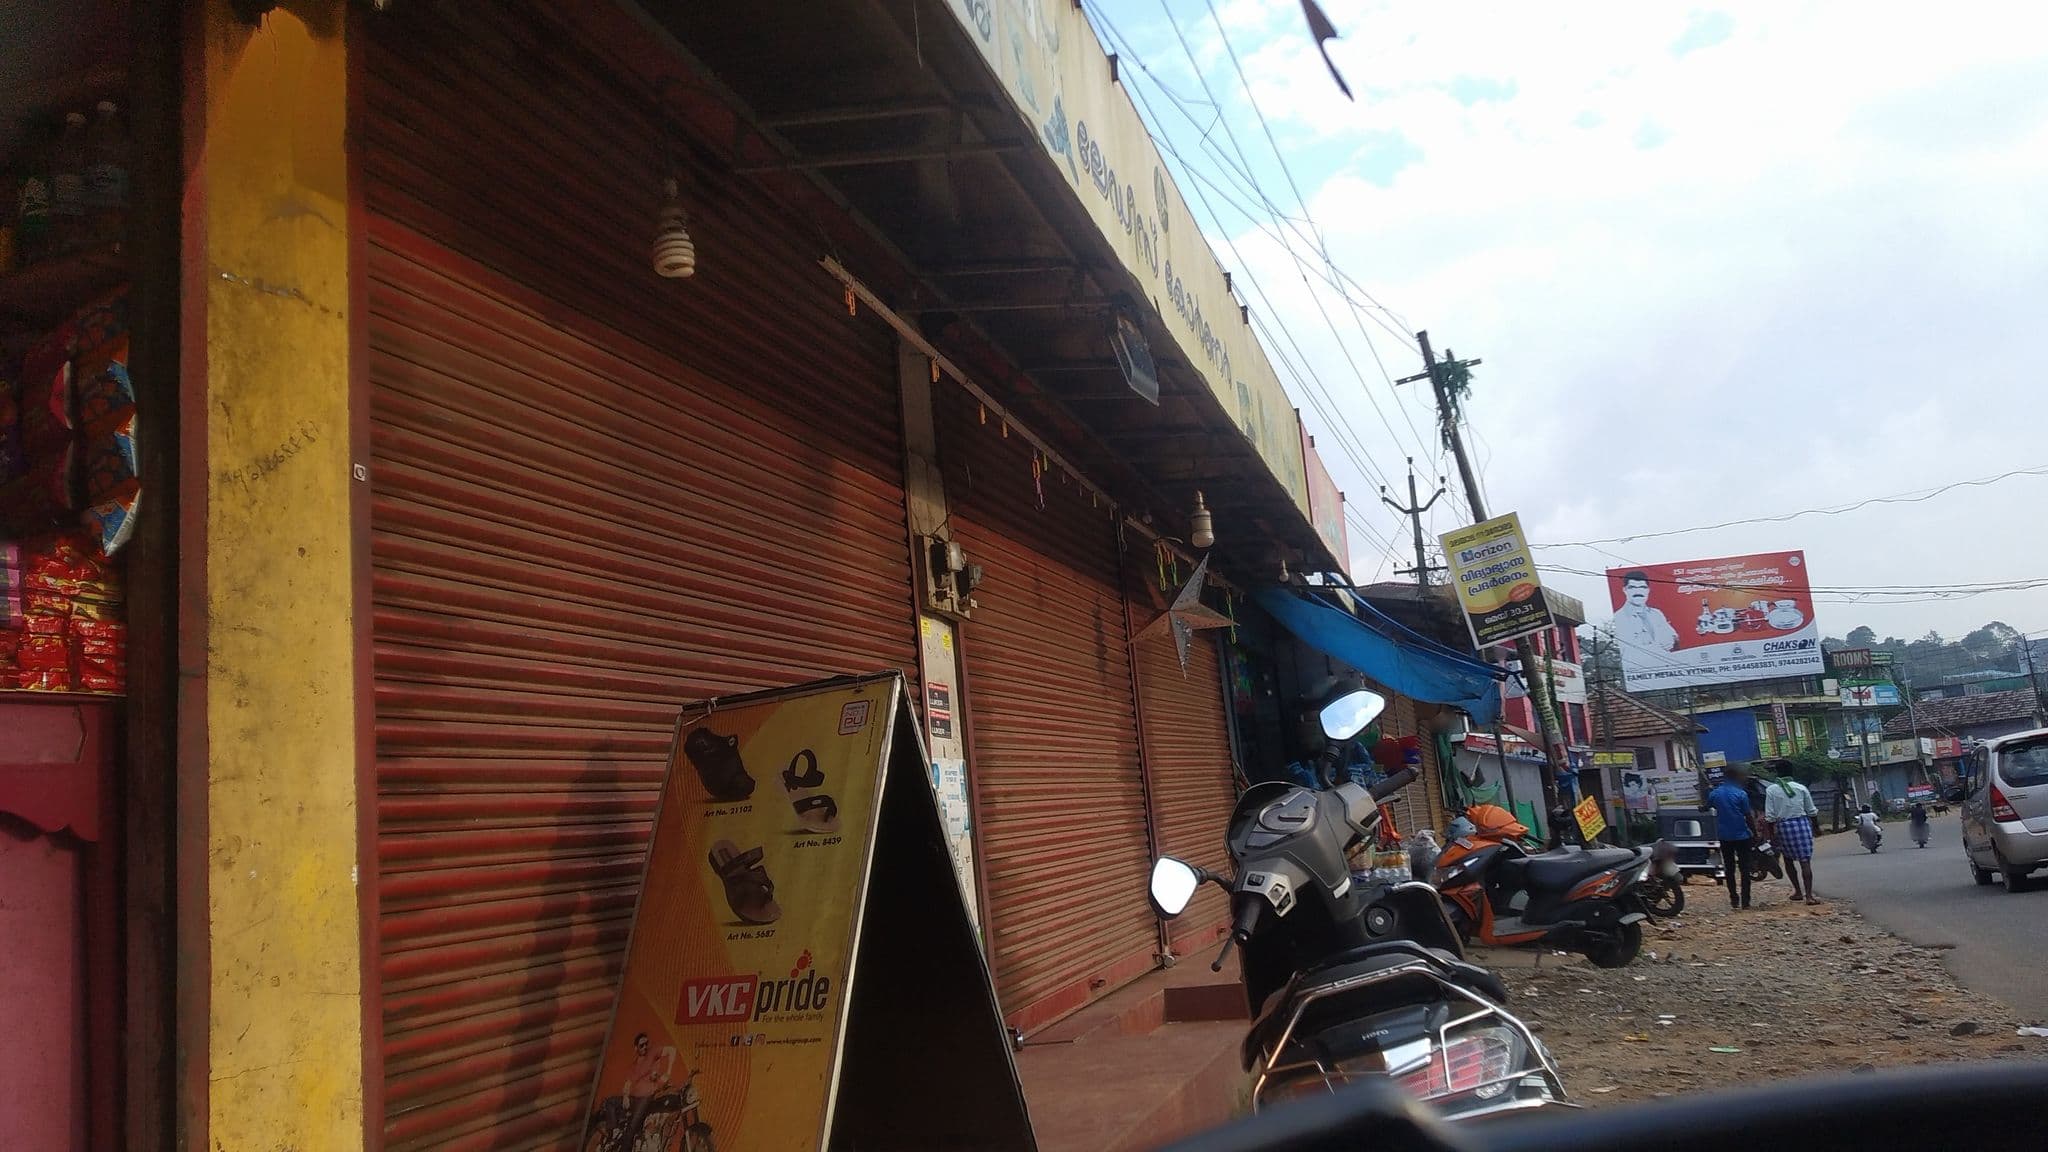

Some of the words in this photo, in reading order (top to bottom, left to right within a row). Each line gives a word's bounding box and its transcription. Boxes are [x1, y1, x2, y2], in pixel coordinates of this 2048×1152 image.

[1763, 638, 1817, 651] CHAKSON
[1833, 651, 1869, 667] ROOMS
[1627, 672, 1654, 681] FAMILY
[807, 839, 820, 847] No.
[726, 932, 738, 941] Art
[687, 983, 752, 1018] VKC
[754, 969, 830, 1023] pride
